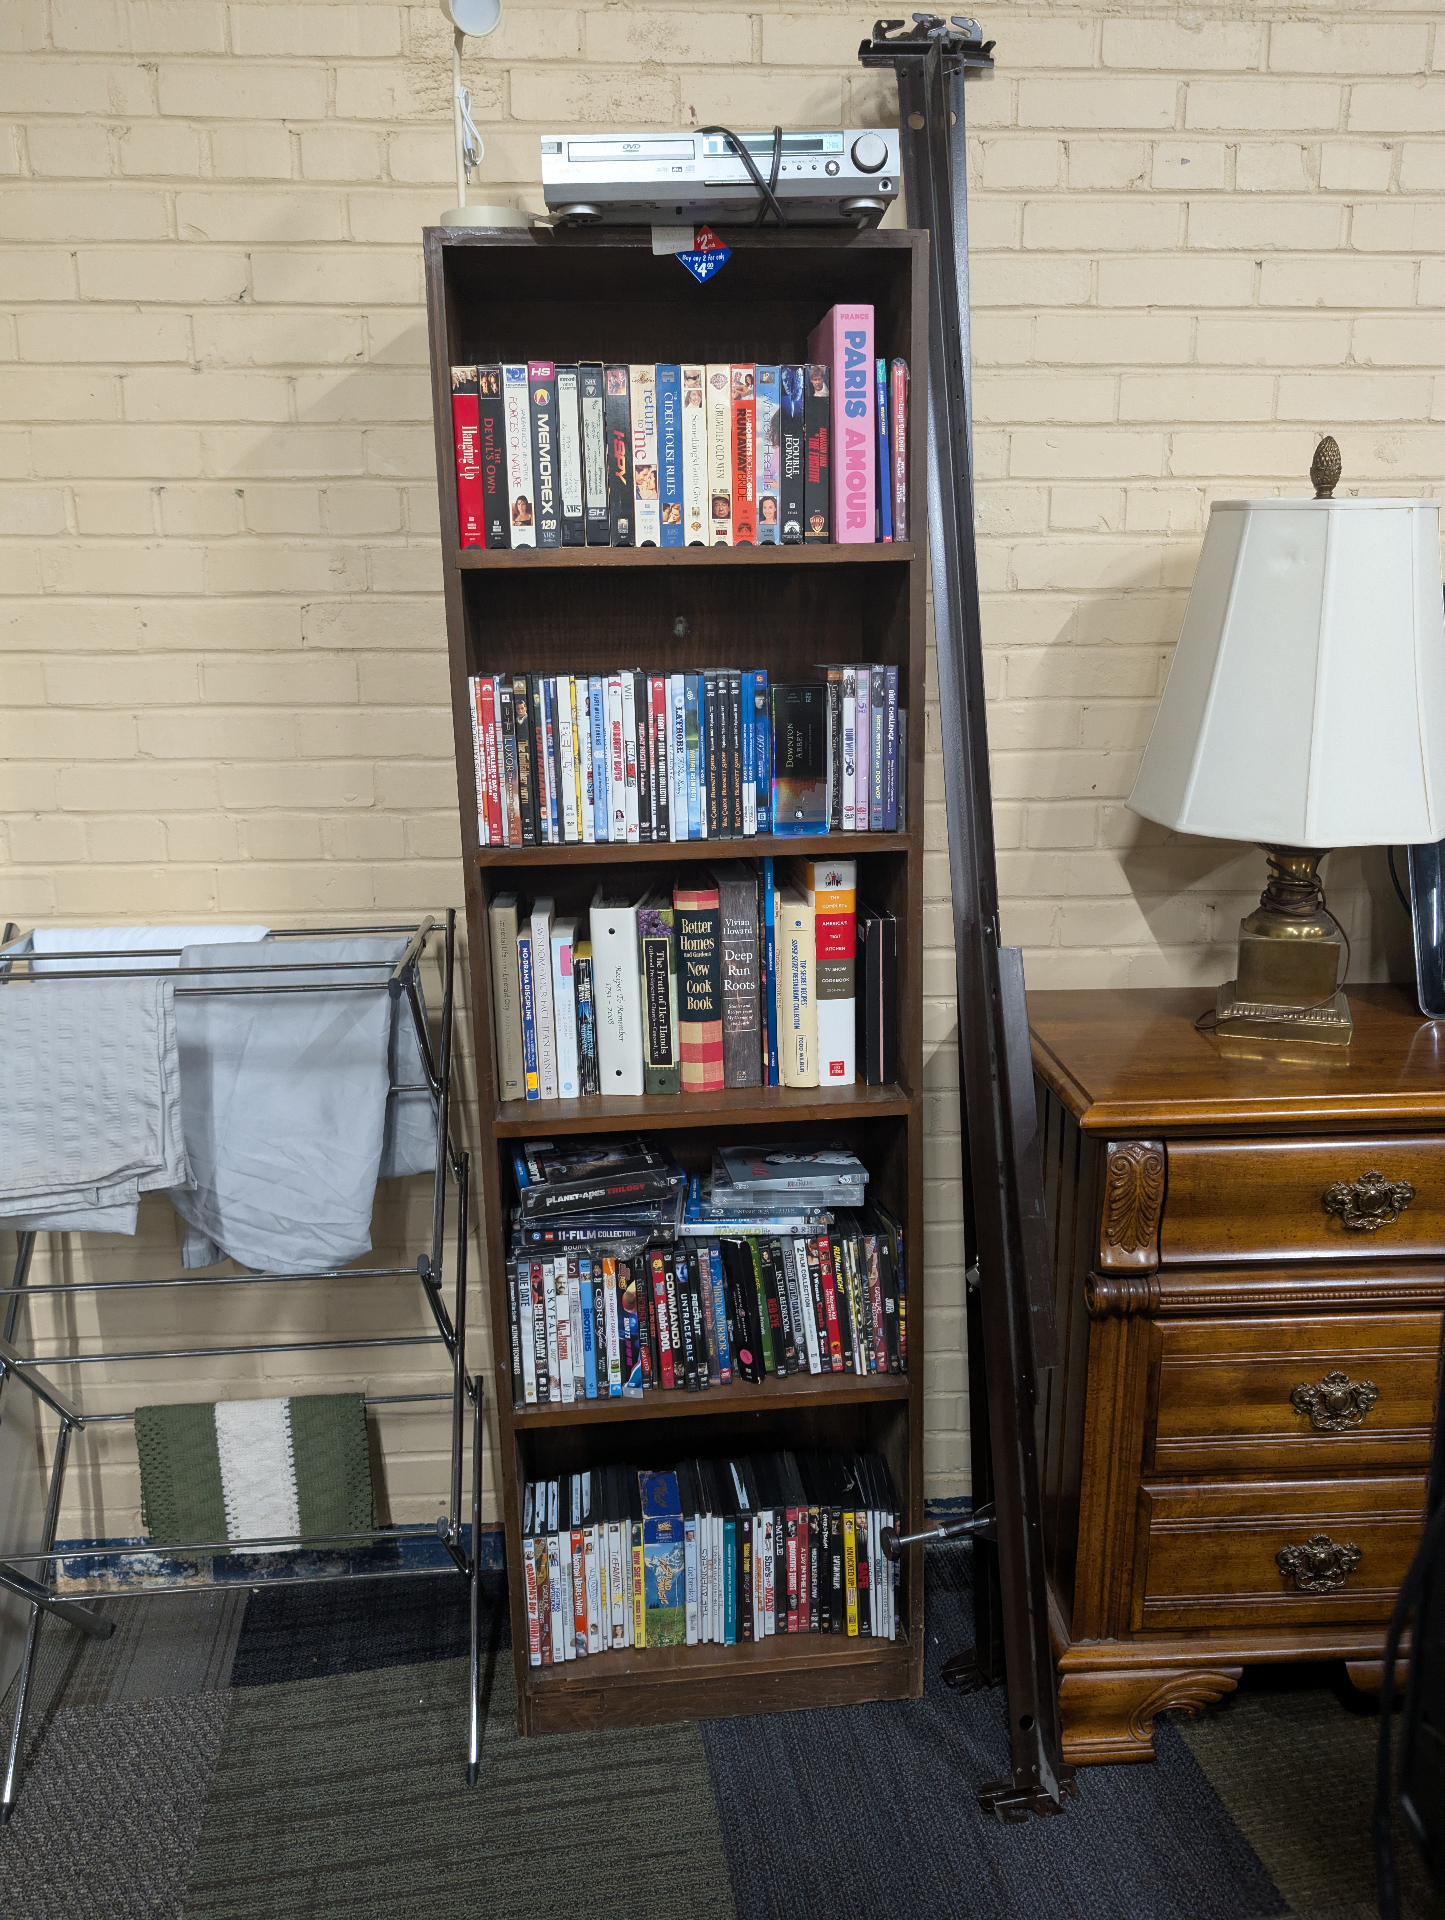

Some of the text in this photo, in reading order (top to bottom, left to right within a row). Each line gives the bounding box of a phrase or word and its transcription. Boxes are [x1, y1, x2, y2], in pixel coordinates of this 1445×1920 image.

[682, 254, 692, 262] Buy
[707, 253, 715, 261] for
[715, 252, 725, 262] only
[840, 313, 869, 321] FRANCE
[532, 367, 552, 377] HS
[643, 389, 656, 437] return
[844, 330, 867, 530] PARIS AMOUR
[457, 426, 480, 480] Hanging Up
[483, 418, 497, 495] DEVIL'S OWN
[494, 448, 502, 464] THE
[508, 396, 523, 488] FORCES OF NATURE
[634, 418, 648, 461] to me
[664, 392, 677, 496] CIDER HOUSE RULES
[715, 403, 727, 480] GRUMPIER OLD MEN
[736, 408, 748, 502] RUNAWAY BRIDE
[784, 433, 795, 480] JEOPARDY
[792, 438, 800, 476] DOUBLE
[537, 414, 554, 515] MEMOREX
[690, 414, 702, 505] Something's Gotta Give
[808, 437, 821, 484] THE FUGITIVE
[541, 519, 557, 530] 120
[565, 504, 581, 514] VHS
[624, 683, 633, 701] Wii
[675, 706, 686, 754] LATROBE
[785, 723, 795, 768] DOWNTON
[795, 730, 804, 760] ABBEY
[488, 723, 500, 804] FERRIS BUELLER'S DAY OFF
[503, 738, 515, 773] LUXOR
[534, 726, 547, 806] CONTRABAND
[559, 721, 574, 778] BELLY
[612, 720, 624, 783] SORORITY BOYS
[499, 918, 508, 944] Imperial
[681, 917, 713, 936] Better
[722, 926, 753, 936] Howard
[724, 918, 751, 928] Vivian
[679, 935, 715, 955] Homes
[724, 949, 753, 967] Deep
[521, 946, 531, 984] NO-DRAMA
[536, 927, 550, 1021] WISDOM YOUR FACE
[686, 960, 710, 977] New
[727, 967, 751, 978] Run
[791, 938, 802, 1030] SUPER SECRET RESTAURANT COLLECTION
[799, 958, 809, 1006] TOP SECRET RECIPES
[501, 972, 511, 999] Emerald
[522, 984, 533, 1021] DISCIPLINE
[612, 965, 627, 1043] Recipes To Remember
[655, 950, 670, 1056] The Fruit of Her Hands
[686, 978, 712, 994] Cook
[686, 996, 713, 1011] Book
[723, 980, 756, 991] Roots
[503, 998, 512, 1012] City
[541, 1024, 554, 1082] JEAN HANER
[797, 1036, 806, 1075] TODD WILBUR
[557, 1229, 638, 1241] 11-FILM COLLECTION
[832, 1245, 843, 1263] RUN
[518, 1271, 531, 1307] DUE DATE
[783, 1250, 803, 1333] STRAIGHT OUTTA OAKLAND
[796, 1246, 811, 1308] 2 FILM COLLECTION
[835, 1272, 846, 1294] NIGHT
[665, 1272, 682, 1349] COMMANDO
[691, 1293, 702, 1336] RECRUIT
[712, 1279, 729, 1351] MIRROR MIRROR
[767, 1298, 781, 1329] RED EYE
[873, 1286, 883, 1315] CADILLAC
[510, 1324, 519, 1347] ULTIMATE
[533, 1303, 547, 1359] BILL BELLAMY
[582, 1307, 592, 1352] BROTHERS
[680, 1292, 695, 1362] UNTRACEABLE
[511, 1346, 521, 1375] TECHNIQUES
[611, 1561, 622, 1586] FAMILY
[632, 1550, 643, 1597] HOW SHE MOVE
[661, 1564, 674, 1592] SOUND
[788, 1540, 798, 1591] BROOKLYN'S FINEST
[800, 1565, 807, 1573] IN
[800, 1572, 808, 1588] THE
[811, 1548, 819, 1599] HUSTLE FLOW
[846, 1546, 856, 1587] KNOCKED UP
[858, 1561, 870, 1590] SAFE
[541, 1584, 550, 1611] CADILLAC
[549, 1576, 558, 1613] TEMPTATIONS
[553, 1587, 562, 1613] FIGHTING
[572, 1553, 584, 1617] HORTON HEARS WHO!
[589, 1566, 600, 1612] AQUAMARINE
[656, 1582, 670, 1605] MUSIC
[800, 1587, 808, 1604] LIFE
[525, 1562, 542, 1654] GRANDMA'S BOY UNRATED
